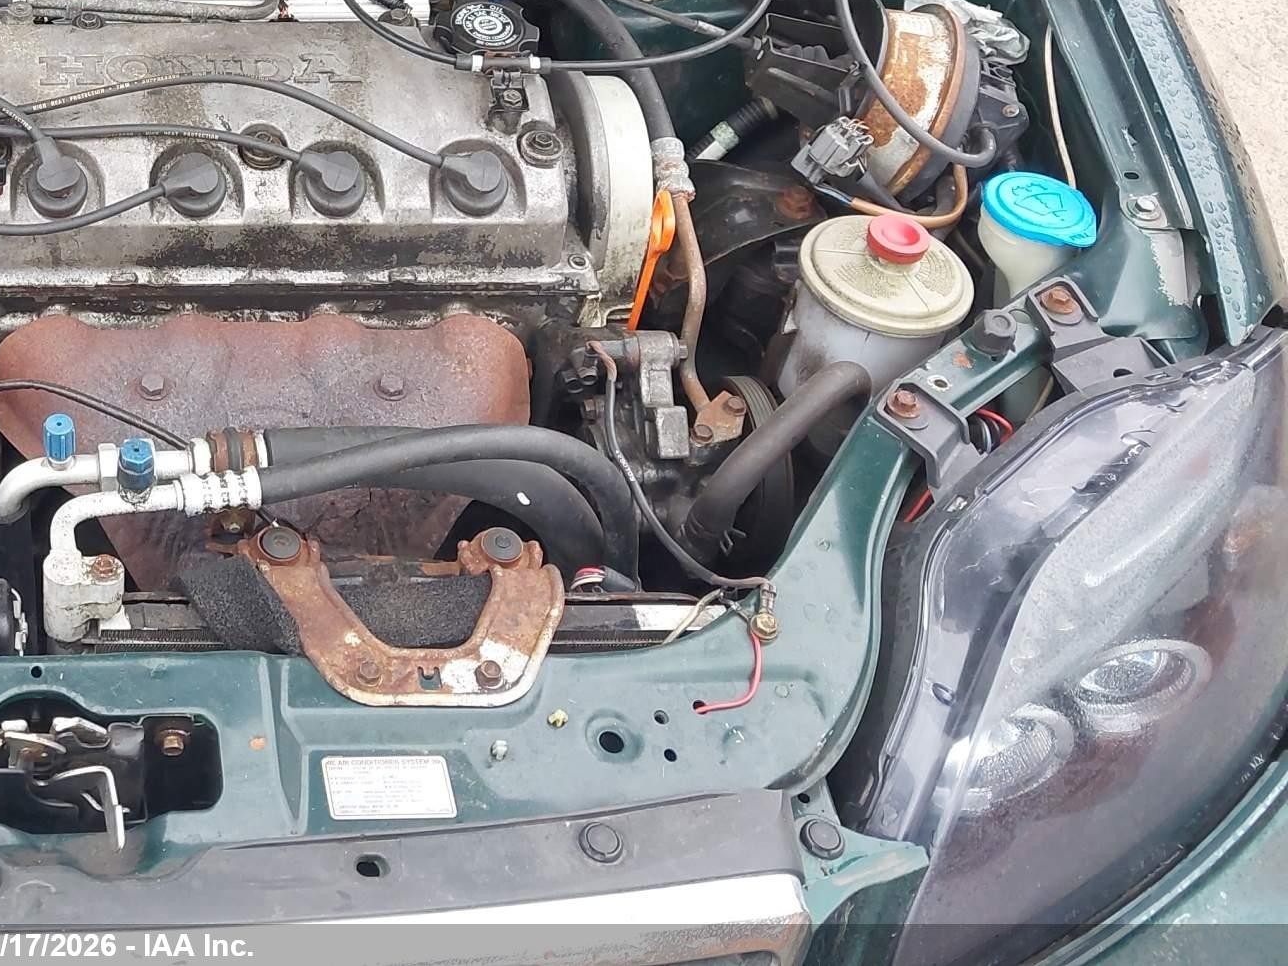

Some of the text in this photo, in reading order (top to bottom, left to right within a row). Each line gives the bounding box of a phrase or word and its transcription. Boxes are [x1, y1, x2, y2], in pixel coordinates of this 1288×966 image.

[489, 5, 504, 14] OIL
[38, 53, 364, 86] HONDA
[50, 98, 66, 106] HEAT
[69, 88, 105, 101] PROTECTION
